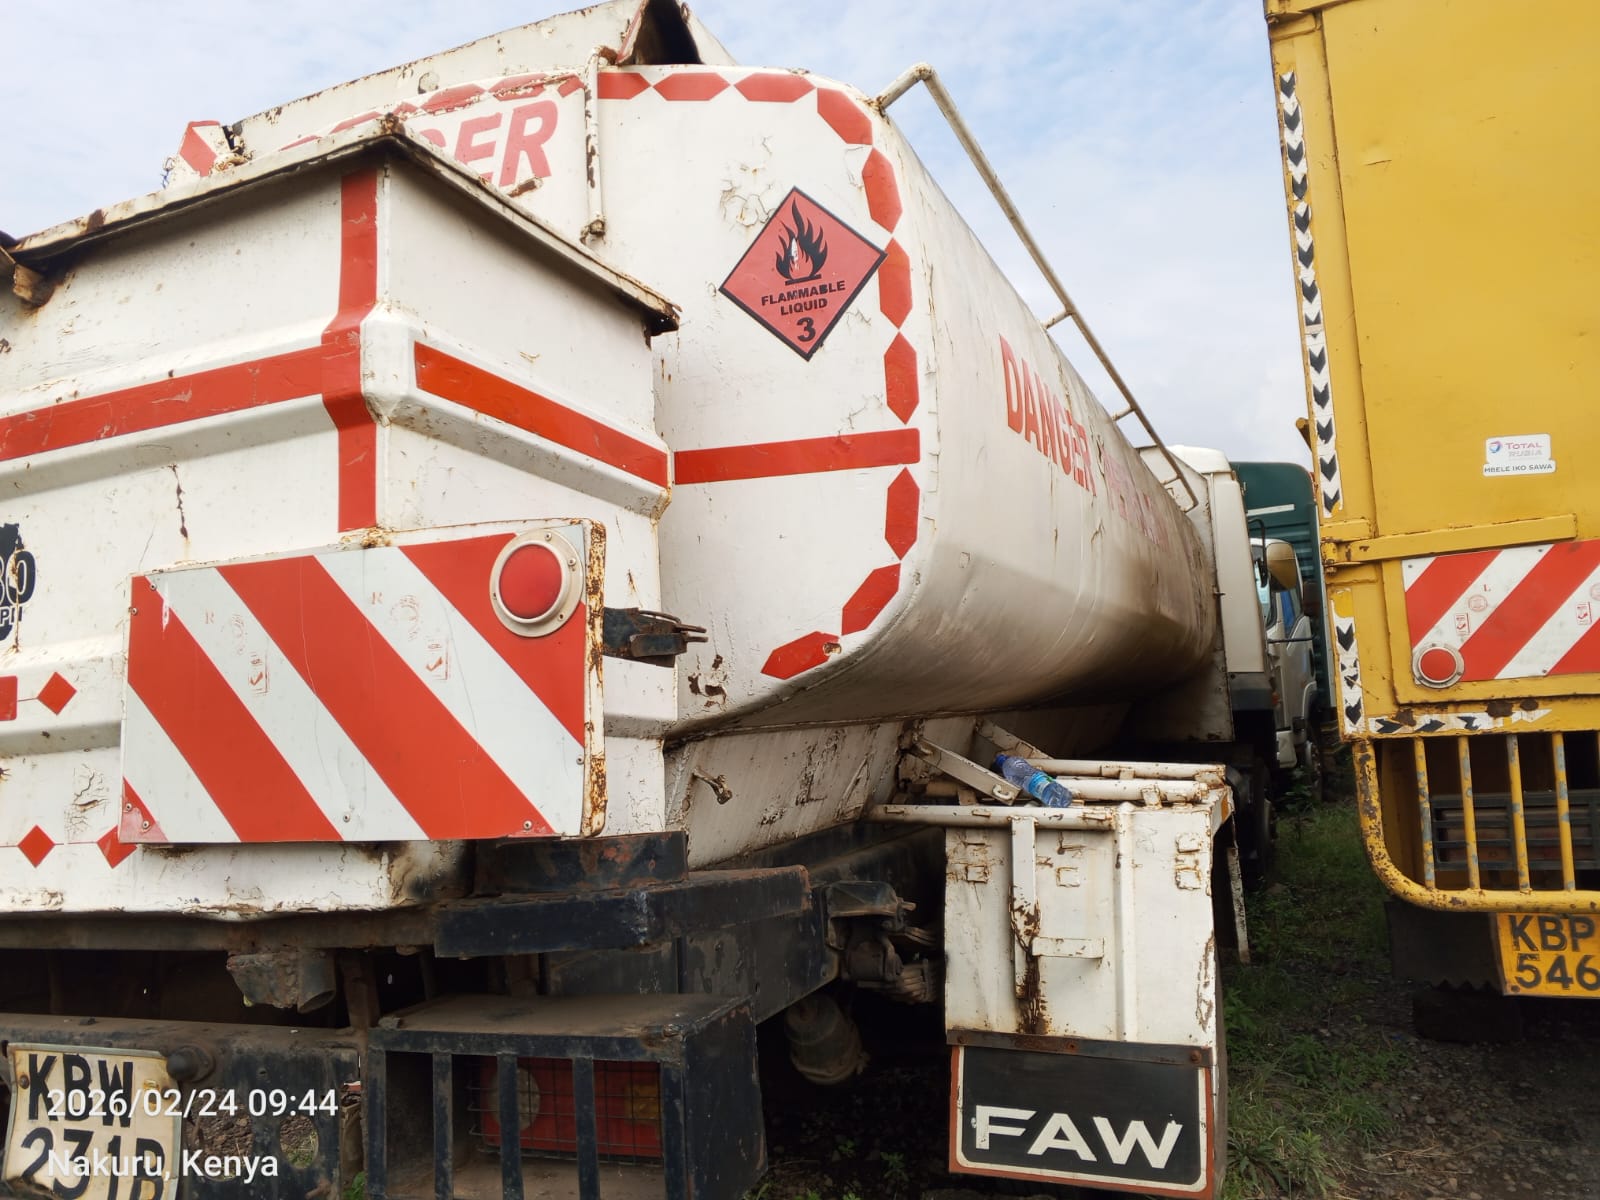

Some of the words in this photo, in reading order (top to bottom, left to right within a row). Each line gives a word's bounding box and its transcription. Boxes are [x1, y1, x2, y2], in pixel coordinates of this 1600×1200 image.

[761, 280, 846, 306] FLAMMABLE
[780, 298, 828, 316] LIQUID
[796, 316, 816, 342] 3
[1000, 333, 1097, 497] DANGER
[1505, 442, 1543, 450] TOTAL
[1484, 465, 1511, 473] MBELE
[1528, 463, 1553, 471] SAWA
[1508, 914, 1595, 952] KBP
[1515, 953, 1600, 991] 546
[28, 1054, 133, 1128] KBW
[976, 1105, 1183, 1169] FAW
